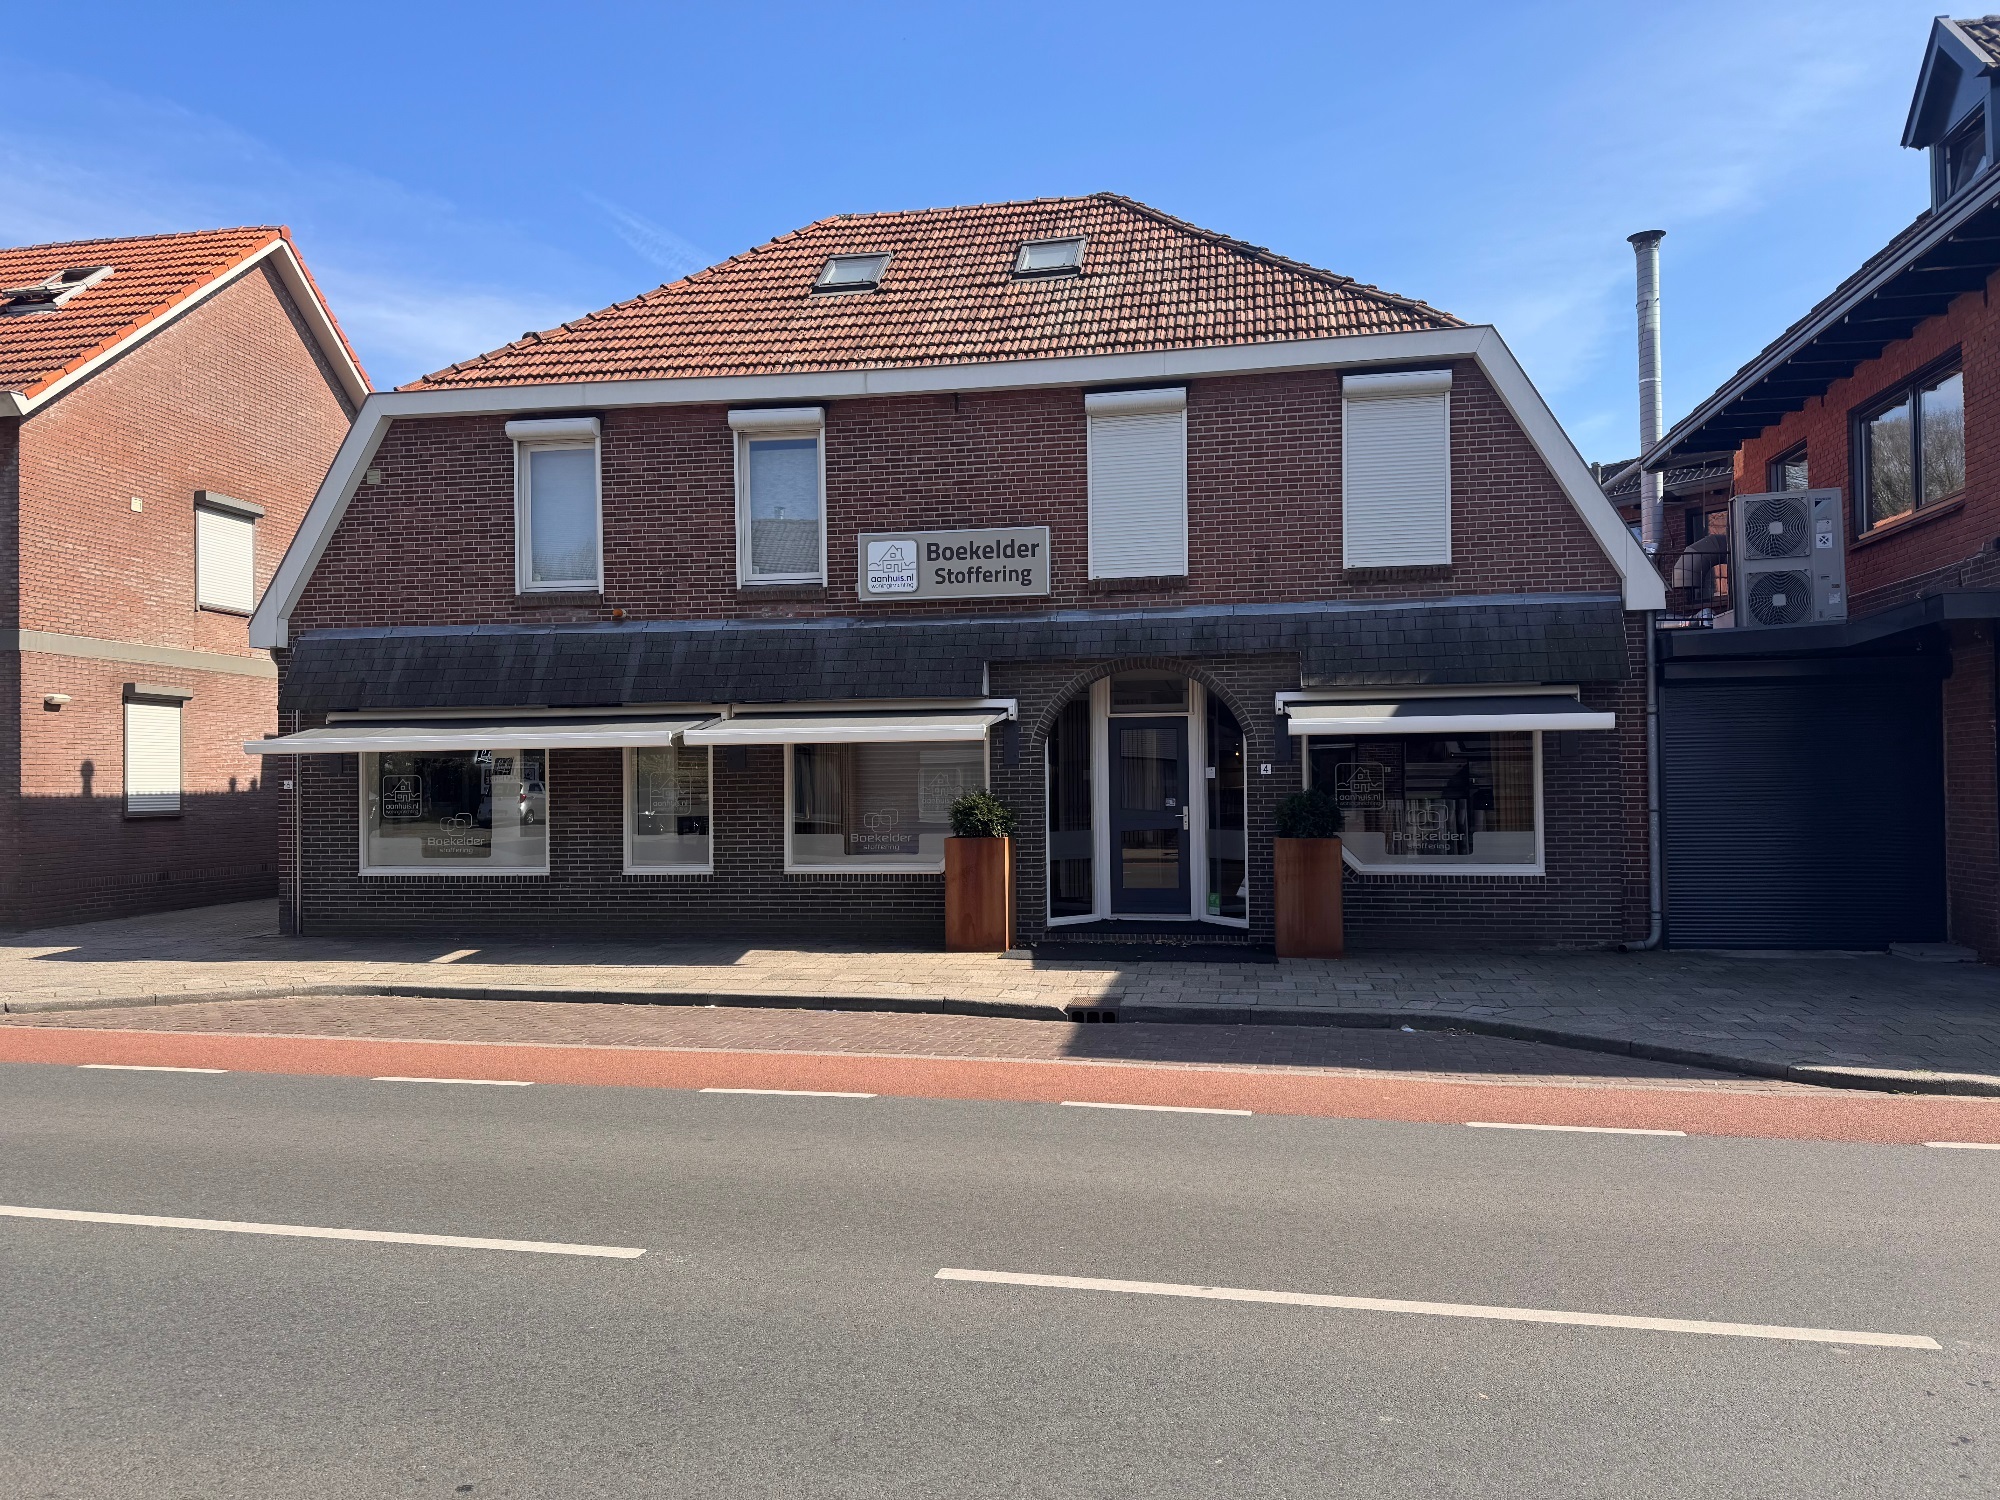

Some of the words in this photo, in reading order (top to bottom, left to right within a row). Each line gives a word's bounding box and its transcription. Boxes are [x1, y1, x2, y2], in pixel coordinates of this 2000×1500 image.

[926, 539, 1040, 562] Boekelder
[870, 573, 914, 583] aanhuis.nl
[934, 565, 1033, 587] Stoffering
[1262, 764, 1269, 773] 4
[1339, 792, 1381, 801] aanhuis.nl
[385, 802, 419, 810] aanhuis.nl
[850, 833, 913, 844] Boekelder
[1392, 831, 1465, 841] Boekelder
[427, 837, 485, 847] Boekelder
[1407, 842, 1451, 851] stoffering
